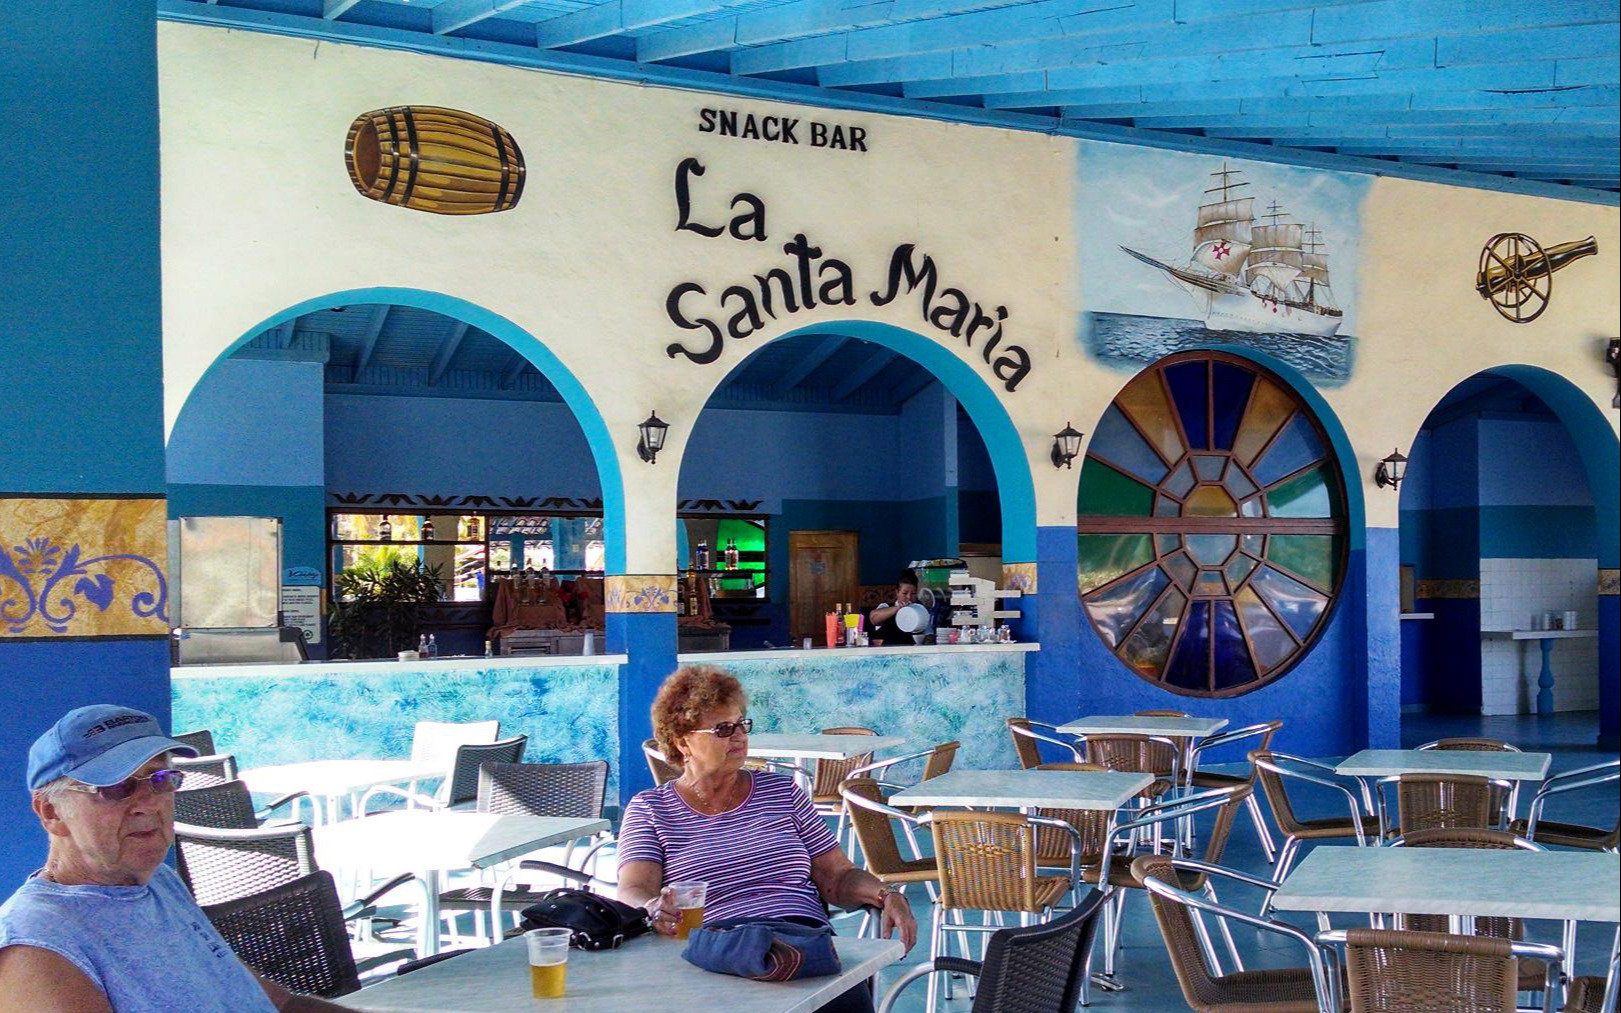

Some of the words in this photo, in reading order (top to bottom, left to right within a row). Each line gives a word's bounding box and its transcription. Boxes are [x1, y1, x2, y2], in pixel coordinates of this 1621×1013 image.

[698, 107, 800, 145] SNACK
[810, 121, 868, 152] BAR
[674, 157, 769, 242] La
[665, 233, 857, 365] Santa
[870, 243, 1032, 393] Maria
